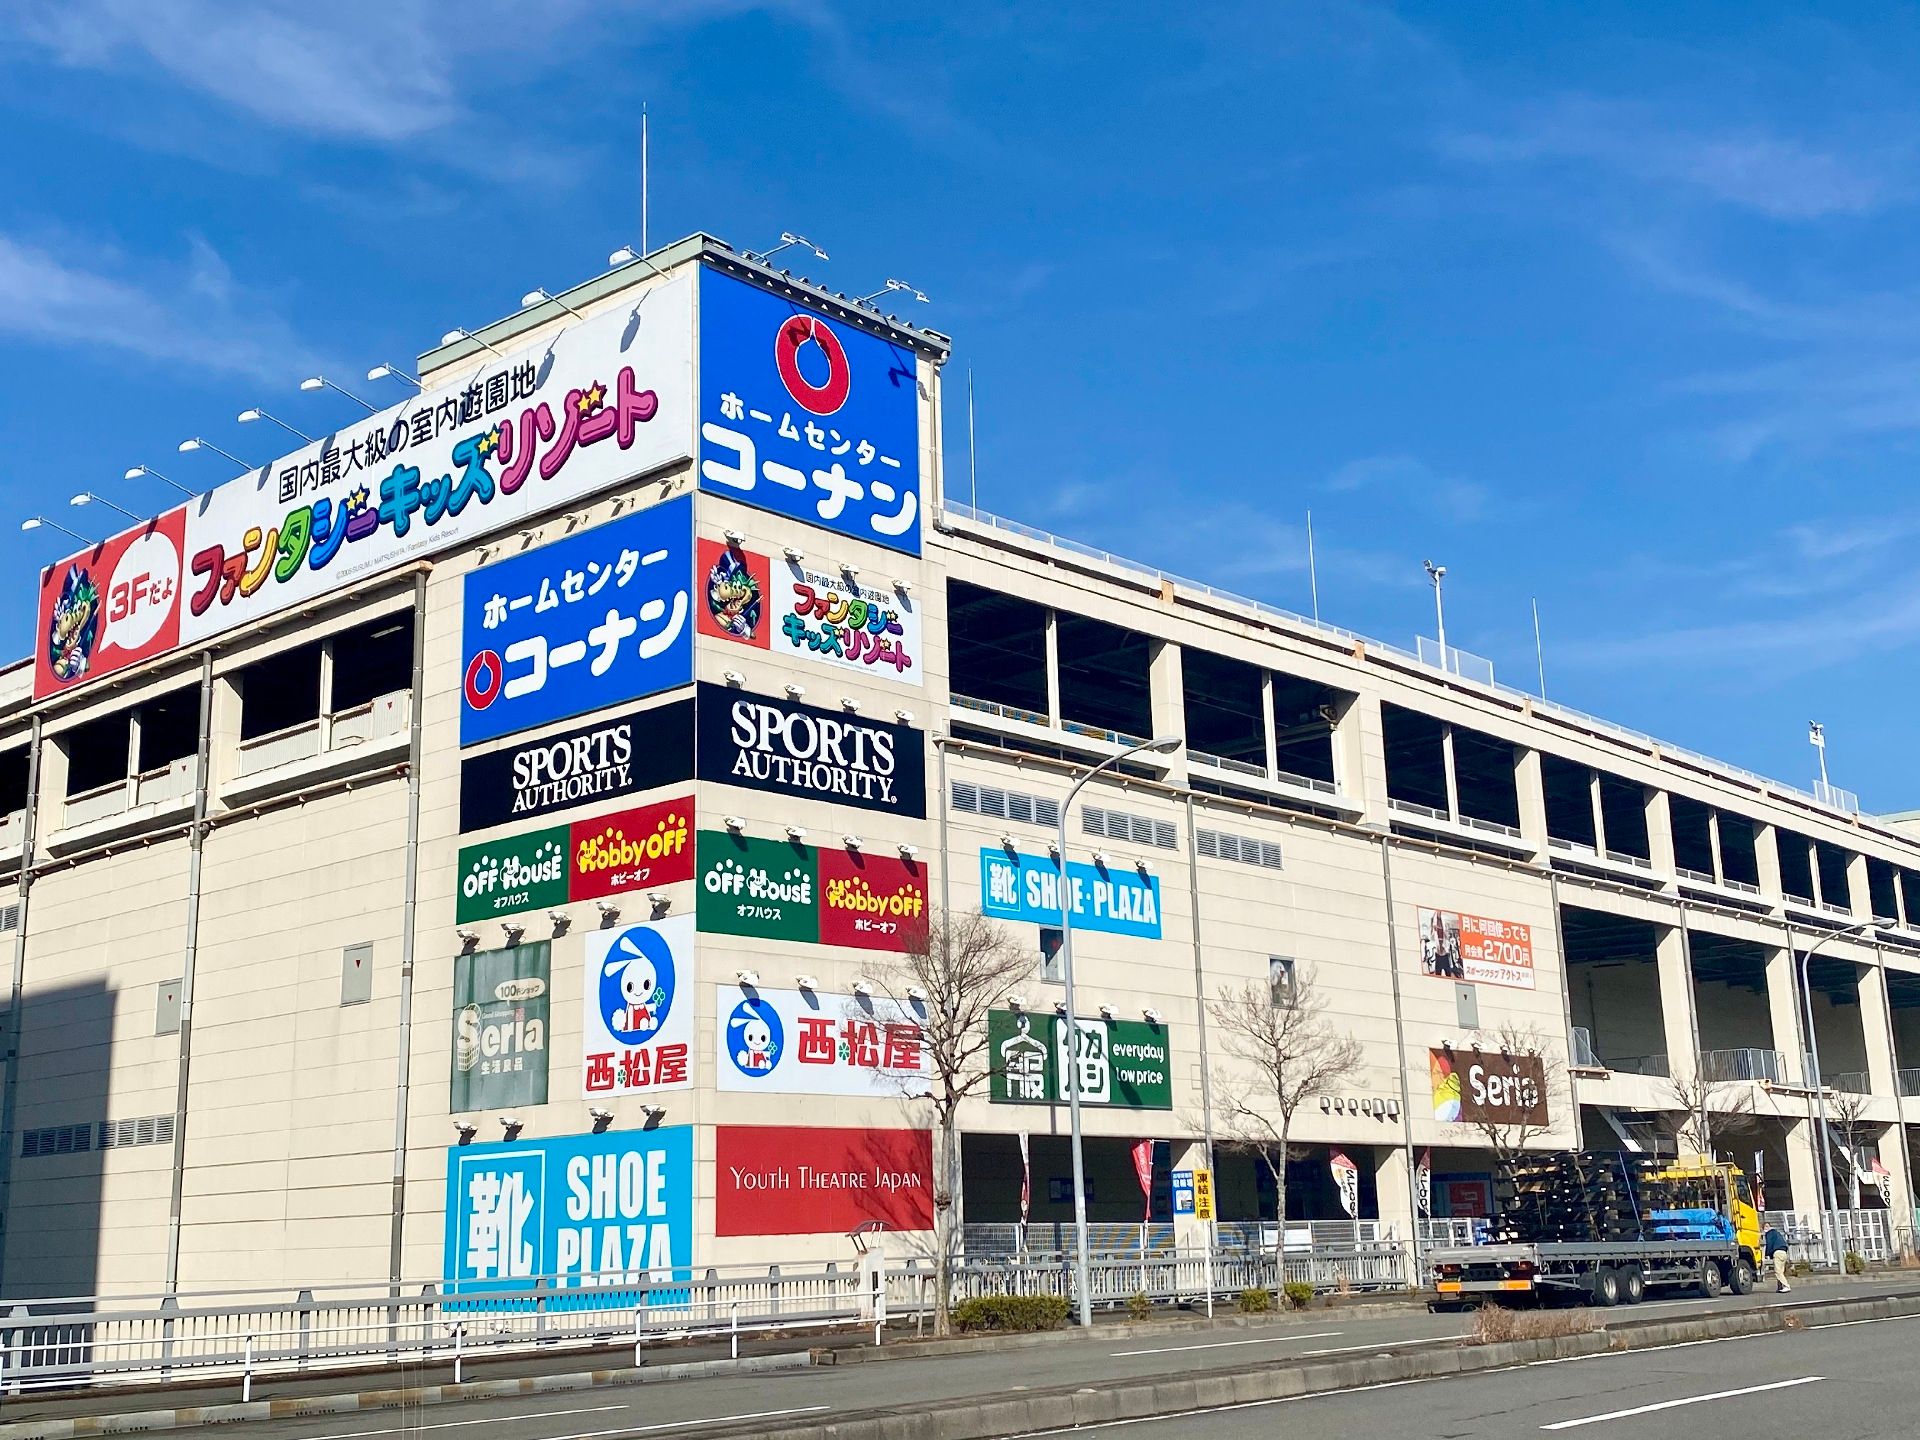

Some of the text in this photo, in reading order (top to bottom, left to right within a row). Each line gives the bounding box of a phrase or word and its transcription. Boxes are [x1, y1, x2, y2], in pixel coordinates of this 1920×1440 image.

[279, 359, 537, 504] 国内最大級の室内遊園地
[720, 391, 901, 468] ホームセンター
[701, 422, 917, 535] コーナン
[109, 571, 173, 623] 3Fだよ
[483, 548, 668, 630] ホームセンター
[793, 583, 904, 636] ファンタジー
[504, 589, 688, 700] コーナン
[782, 612, 912, 673] キッズリゾート
[512, 724, 632, 789] SPORTS
[731, 700, 896, 776] SPORTS
[493, 891, 530, 910] オフハウス
[610, 867, 650, 887] ホビーオフ
[989, 862, 1017, 905] 靴
[737, 904, 782, 921] オフハウス
[854, 918, 897, 934] ホビーオフ
[457, 1008, 545, 1057] Seria
[797, 1016, 921, 1070] 西松屋
[1112, 1042, 1165, 1063] everyday
[585, 1042, 689, 1092] 西松屋
[1115, 1066, 1164, 1086] low price
[1469, 1063, 1539, 1108] Seria
[566, 1149, 667, 1221] SHOE
[1196, 1172, 1211, 1219] 凍結注意
[466, 1170, 535, 1280] 靴
[556, 1223, 673, 1290] PLAZA
